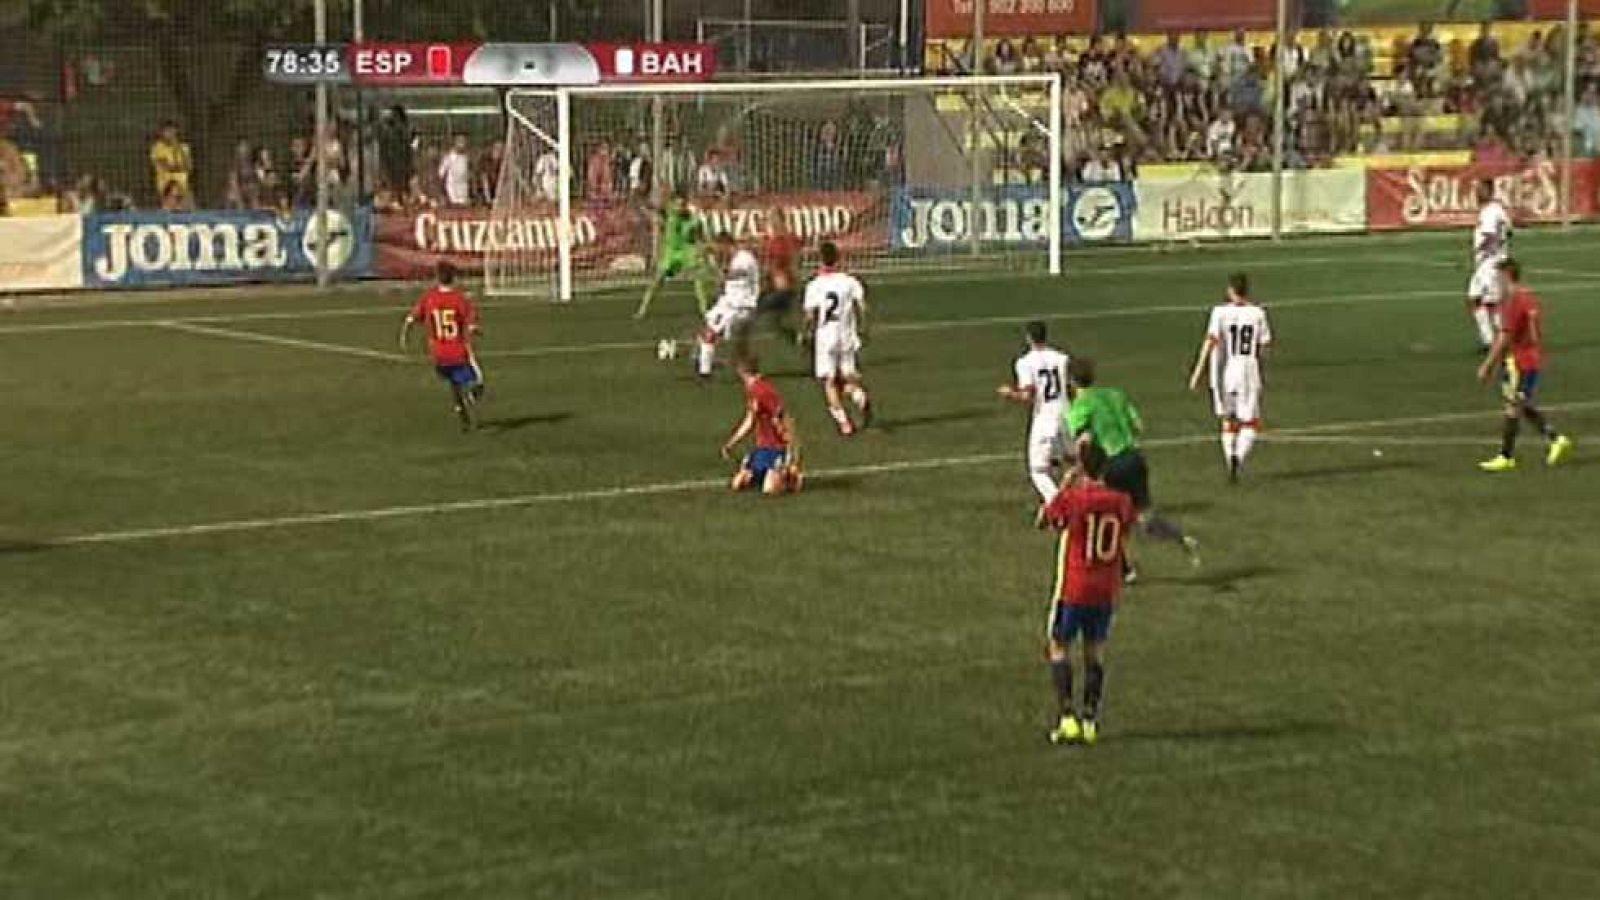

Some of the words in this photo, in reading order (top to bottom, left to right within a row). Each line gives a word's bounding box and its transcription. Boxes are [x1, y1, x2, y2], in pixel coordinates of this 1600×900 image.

[96, 223, 287, 281] Joma
[432, 309, 457, 339] 15
[823, 291, 841, 325] 2
[1230, 324, 1254, 356] 18
[1037, 366, 1061, 403] 21
[1085, 512, 1120, 563] 10
